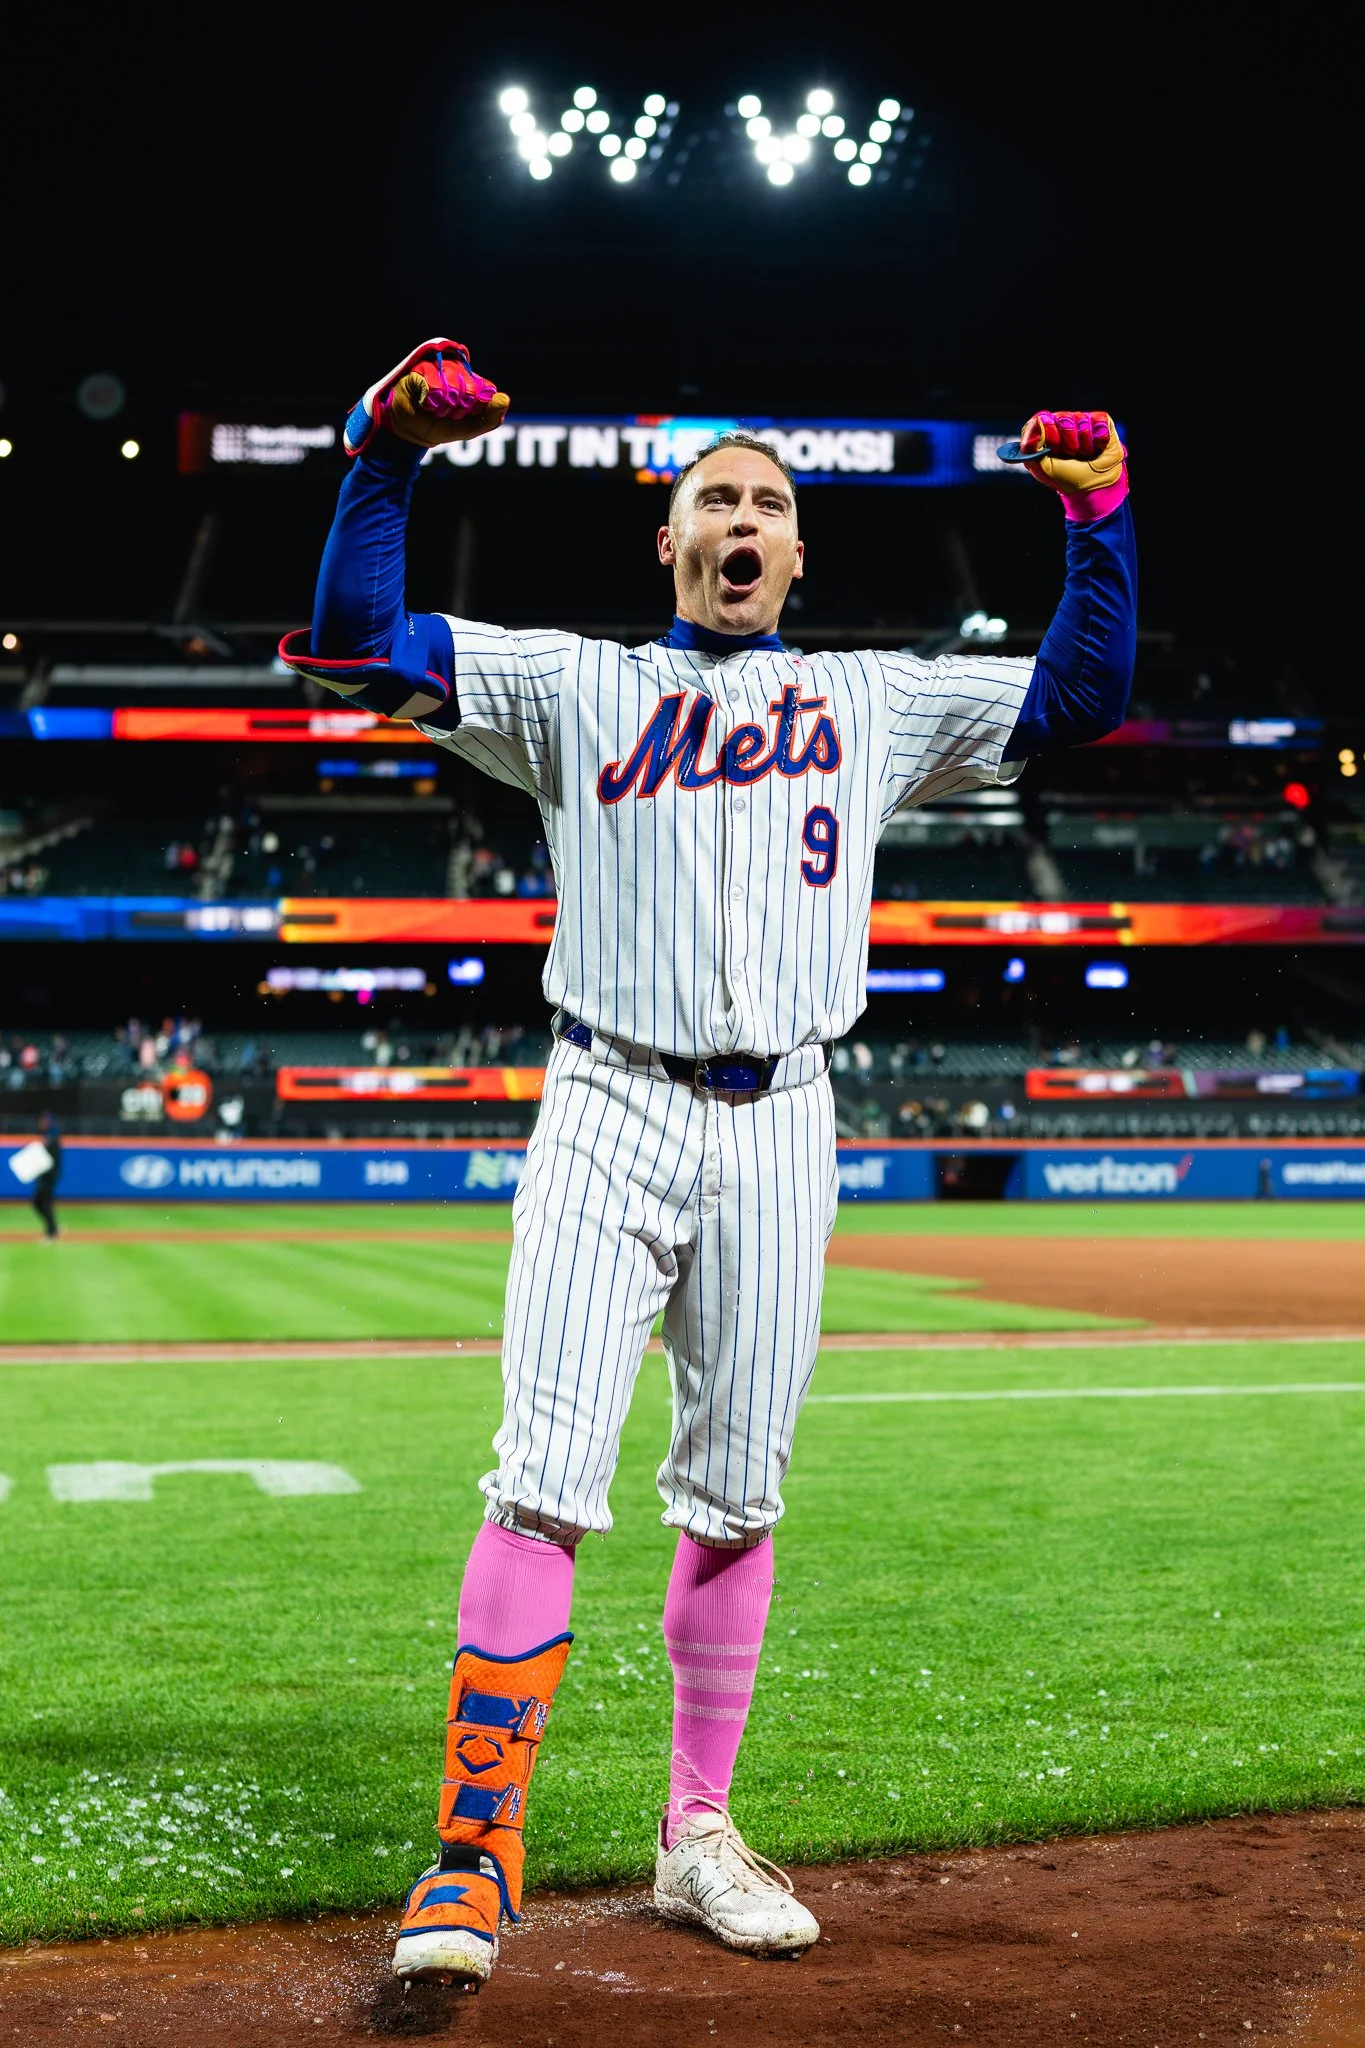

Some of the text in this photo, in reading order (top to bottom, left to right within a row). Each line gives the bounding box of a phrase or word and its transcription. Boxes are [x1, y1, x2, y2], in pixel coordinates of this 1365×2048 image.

[516, 425, 567, 468] IT
[568, 425, 619, 469] IN
[597, 684, 843, 805] Mets
[800, 804, 840, 888] 9
[178, 1158, 321, 1187] HYUNDAI
[1043, 1155, 1178, 1193] verizon
